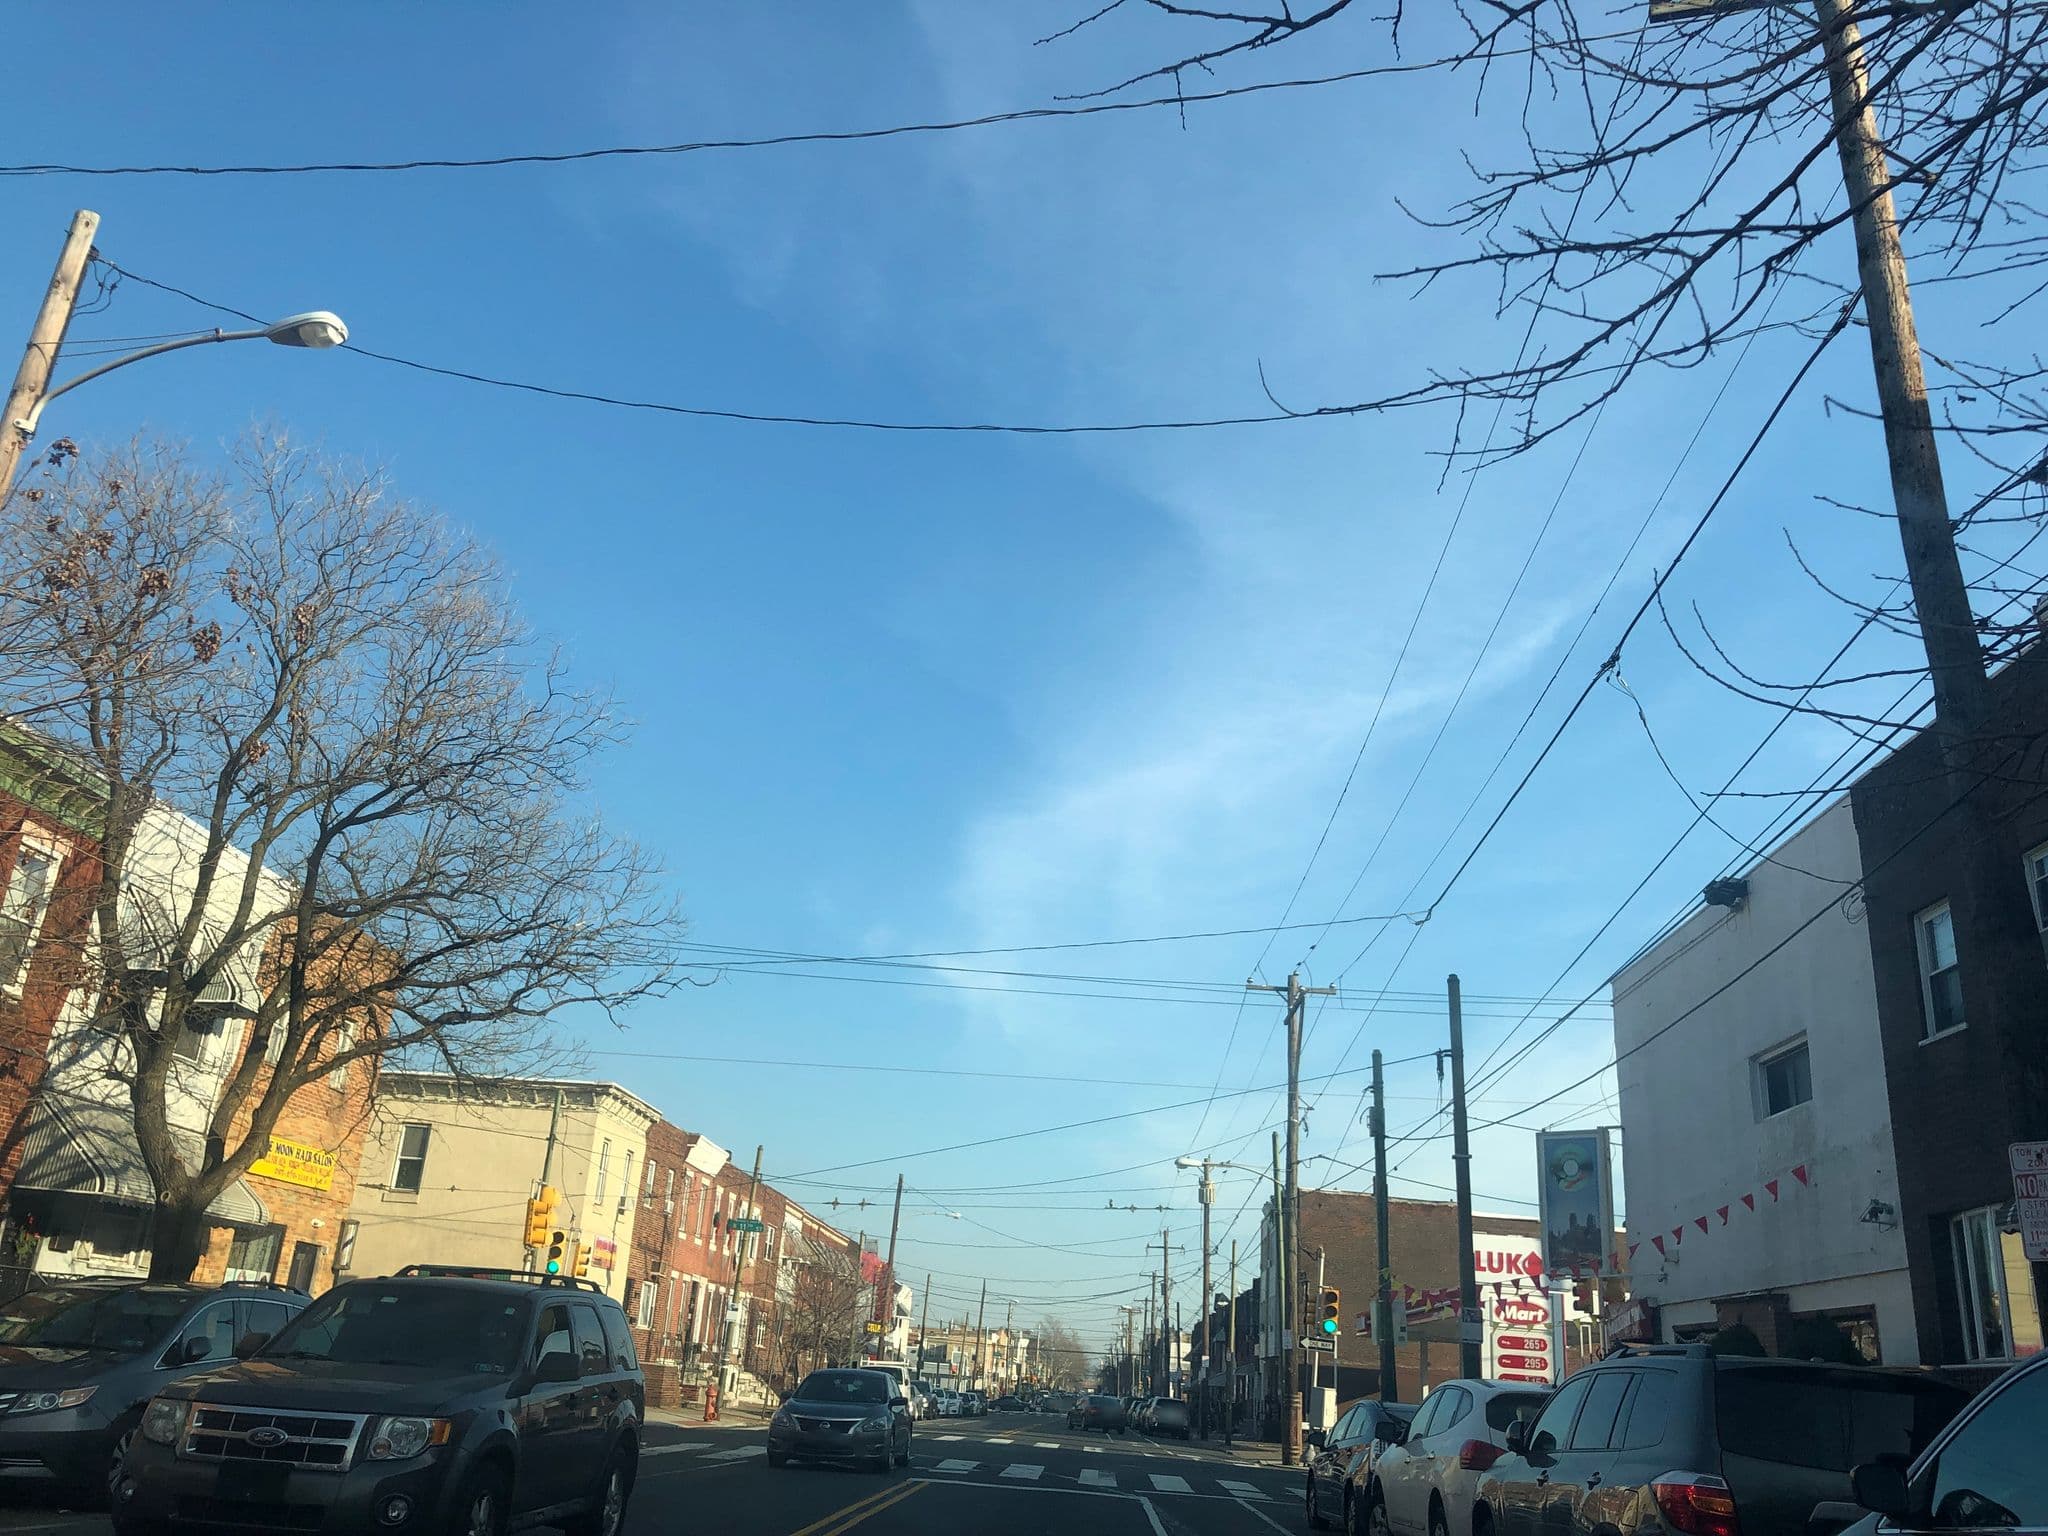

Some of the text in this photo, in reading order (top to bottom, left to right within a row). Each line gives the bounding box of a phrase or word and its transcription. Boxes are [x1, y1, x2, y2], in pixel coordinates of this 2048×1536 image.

[276, 1142, 294, 1157] MOON
[295, 1148, 312, 1162] HAIR
[312, 1152, 332, 1167] SALON
[2016, 1177, 2038, 1198] NO
[1500, 1304, 1544, 1321] Mart
[1524, 1339, 1540, 1349] 265
[1524, 1358, 1541, 1368] 295
